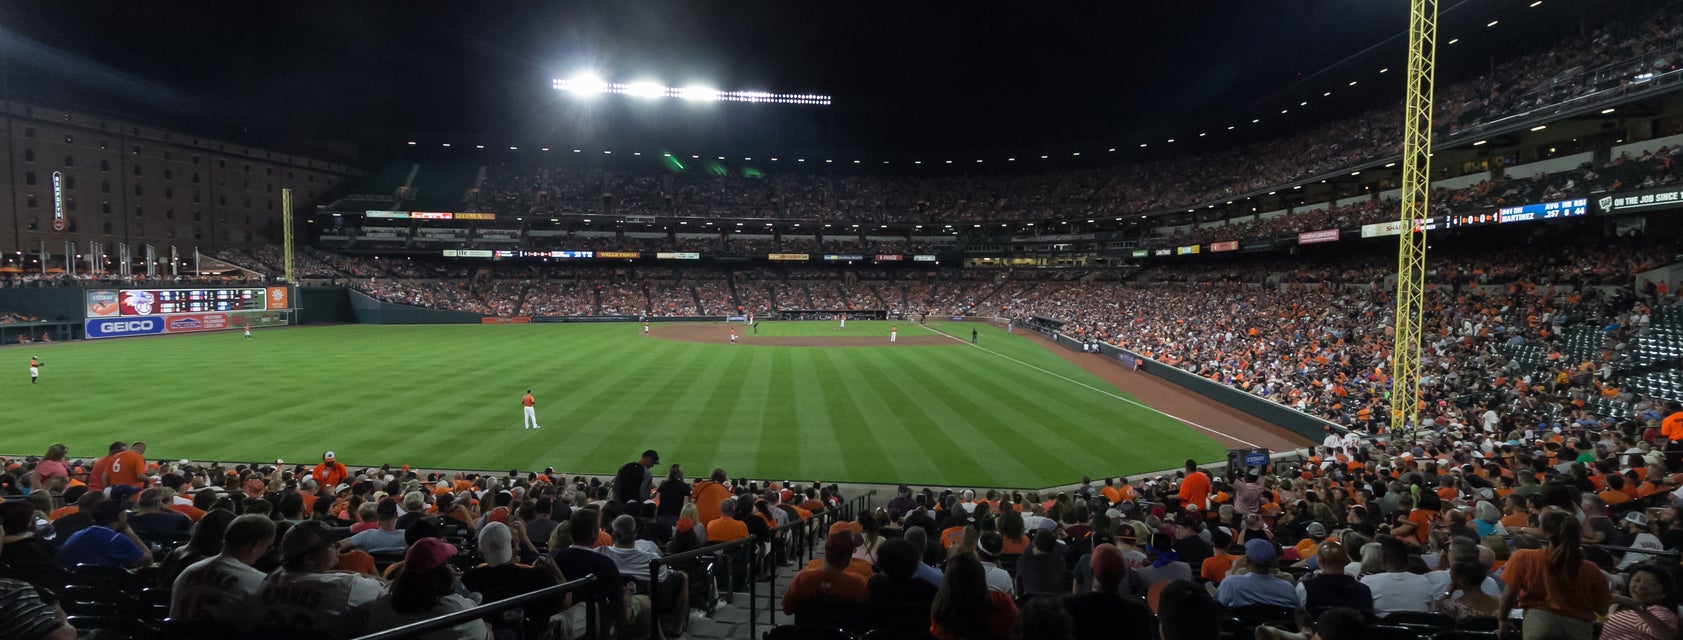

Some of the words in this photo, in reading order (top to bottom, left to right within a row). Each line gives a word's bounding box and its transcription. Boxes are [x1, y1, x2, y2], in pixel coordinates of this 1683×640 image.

[1545, 202, 1560, 210] AVG
[1574, 198, 1587, 206] RBI
[1614, 198, 1624, 206] ON
[1625, 196, 1639, 205] THE
[1639, 194, 1655, 204] JOB
[1655, 191, 1679, 202] SINCE
[1575, 207, 1585, 215] 44
[1467, 215, 1474, 224] 0
[1479, 213, 1486, 223] 0
[1492, 212, 1498, 222] 1
[1502, 212, 1535, 223] MARTINEZ
[101, 320, 154, 333] GEICO
[112, 457, 121, 473] 6
